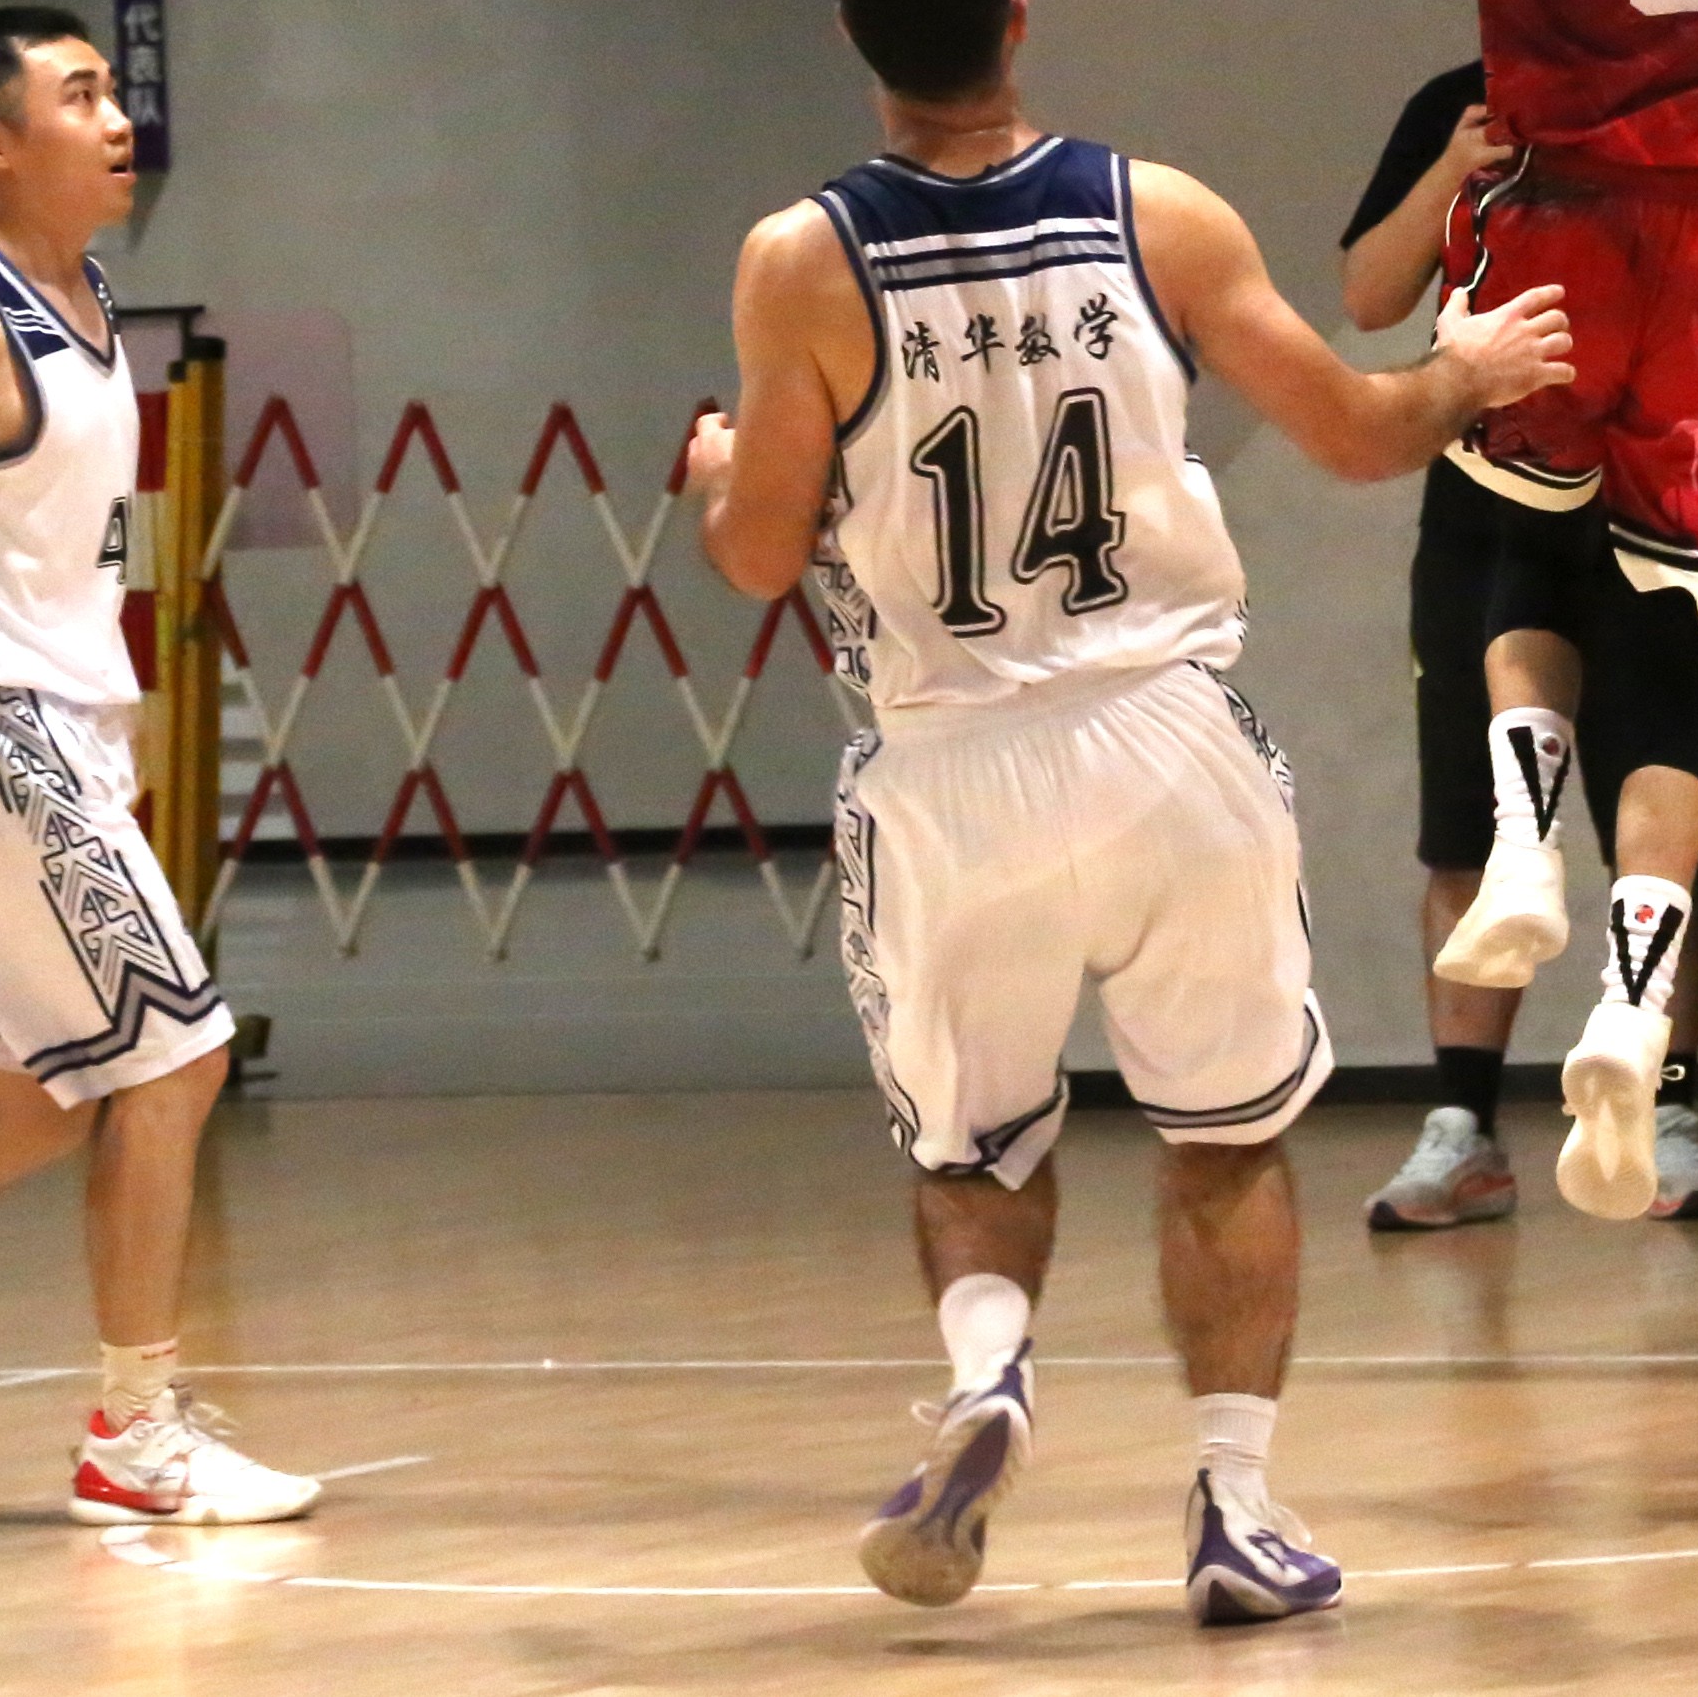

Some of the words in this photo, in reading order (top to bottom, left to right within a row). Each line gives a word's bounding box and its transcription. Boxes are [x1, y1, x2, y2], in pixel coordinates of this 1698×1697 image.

[902, 293, 1118, 382] 清华数学
[910, 387, 1128, 639] 14
